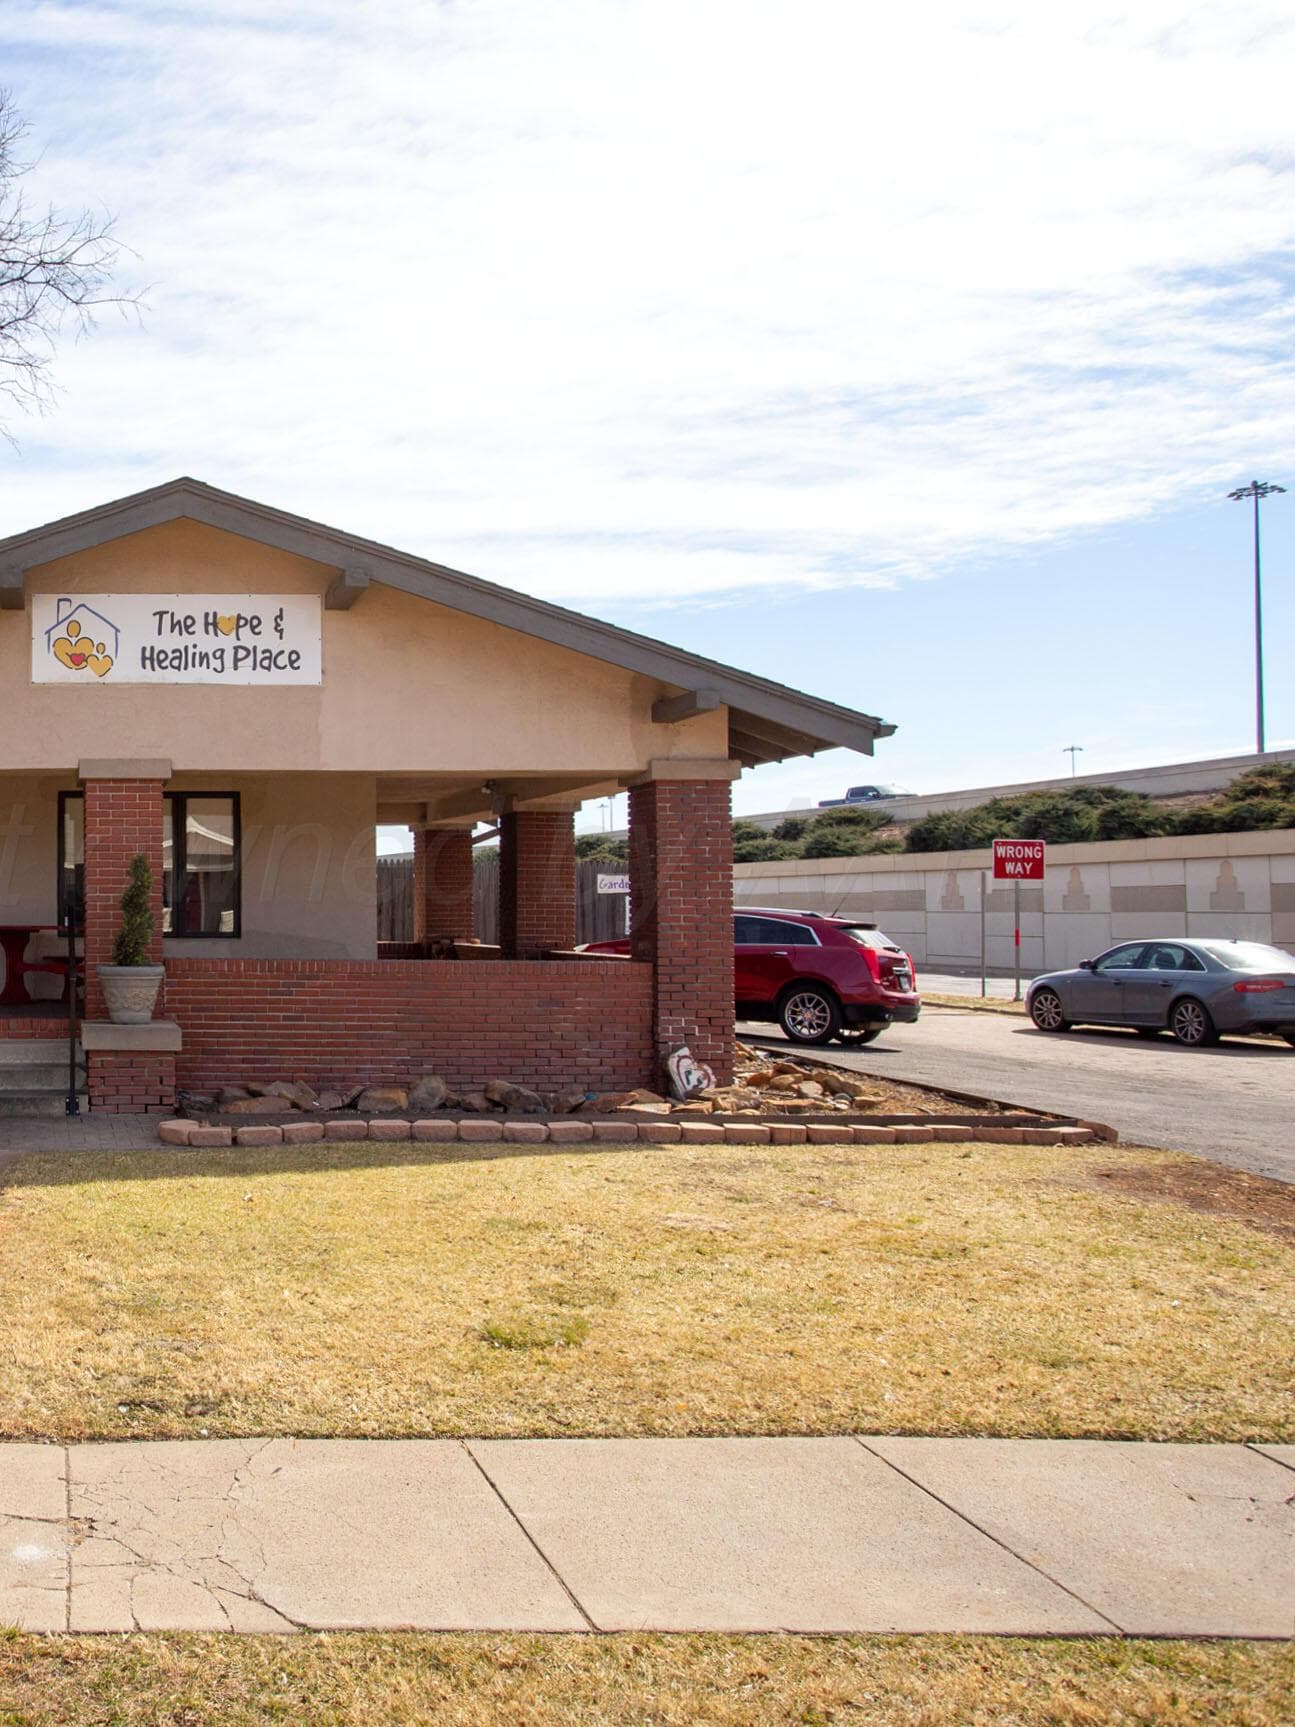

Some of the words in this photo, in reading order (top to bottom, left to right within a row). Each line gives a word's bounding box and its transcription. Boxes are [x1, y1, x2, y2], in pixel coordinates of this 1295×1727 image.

[152, 609, 197, 637] The
[273, 606, 284, 641] &
[140, 643, 225, 674] Healing
[232, 645, 302, 672] Place
[996, 845, 1042, 859] WRONG
[1005, 862, 1033, 875] WAY
